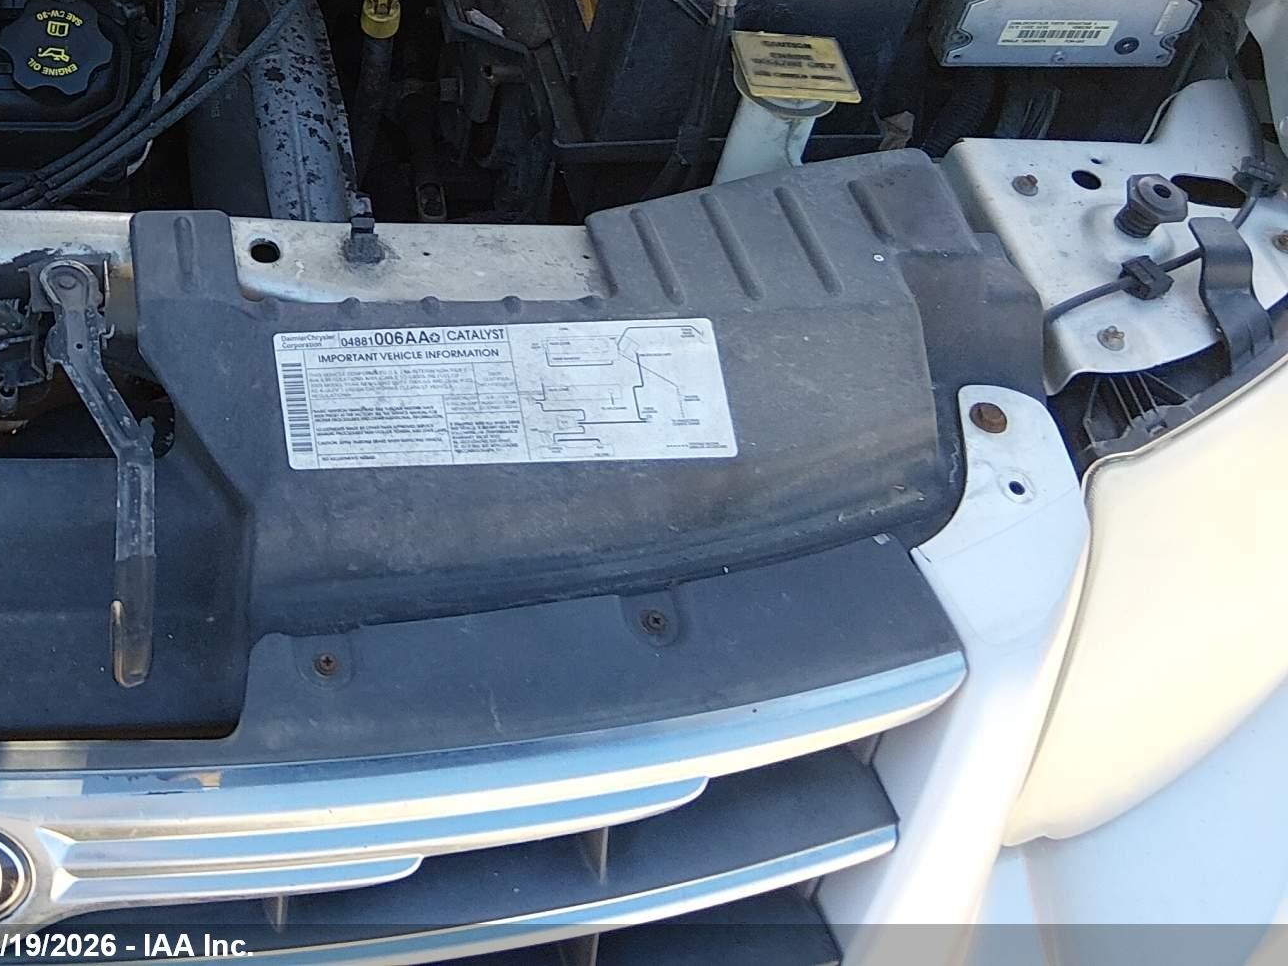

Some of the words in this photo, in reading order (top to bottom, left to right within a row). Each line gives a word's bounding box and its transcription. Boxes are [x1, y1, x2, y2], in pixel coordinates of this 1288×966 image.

[65, 13, 83, 27] SAE
[26, 57, 42, 71] OIL
[41, 63, 79, 76] ENGINE
[280, 334, 335, 344] DaimlerChrysler
[340, 330, 430, 347] 04881006AA
[446, 328, 505, 342] CATALYST
[281, 341, 323, 350] Corporation
[318, 352, 378, 363] IMPORTANT
[381, 350, 423, 362] VEHICLE
[425, 348, 500, 360] INFORMATION
